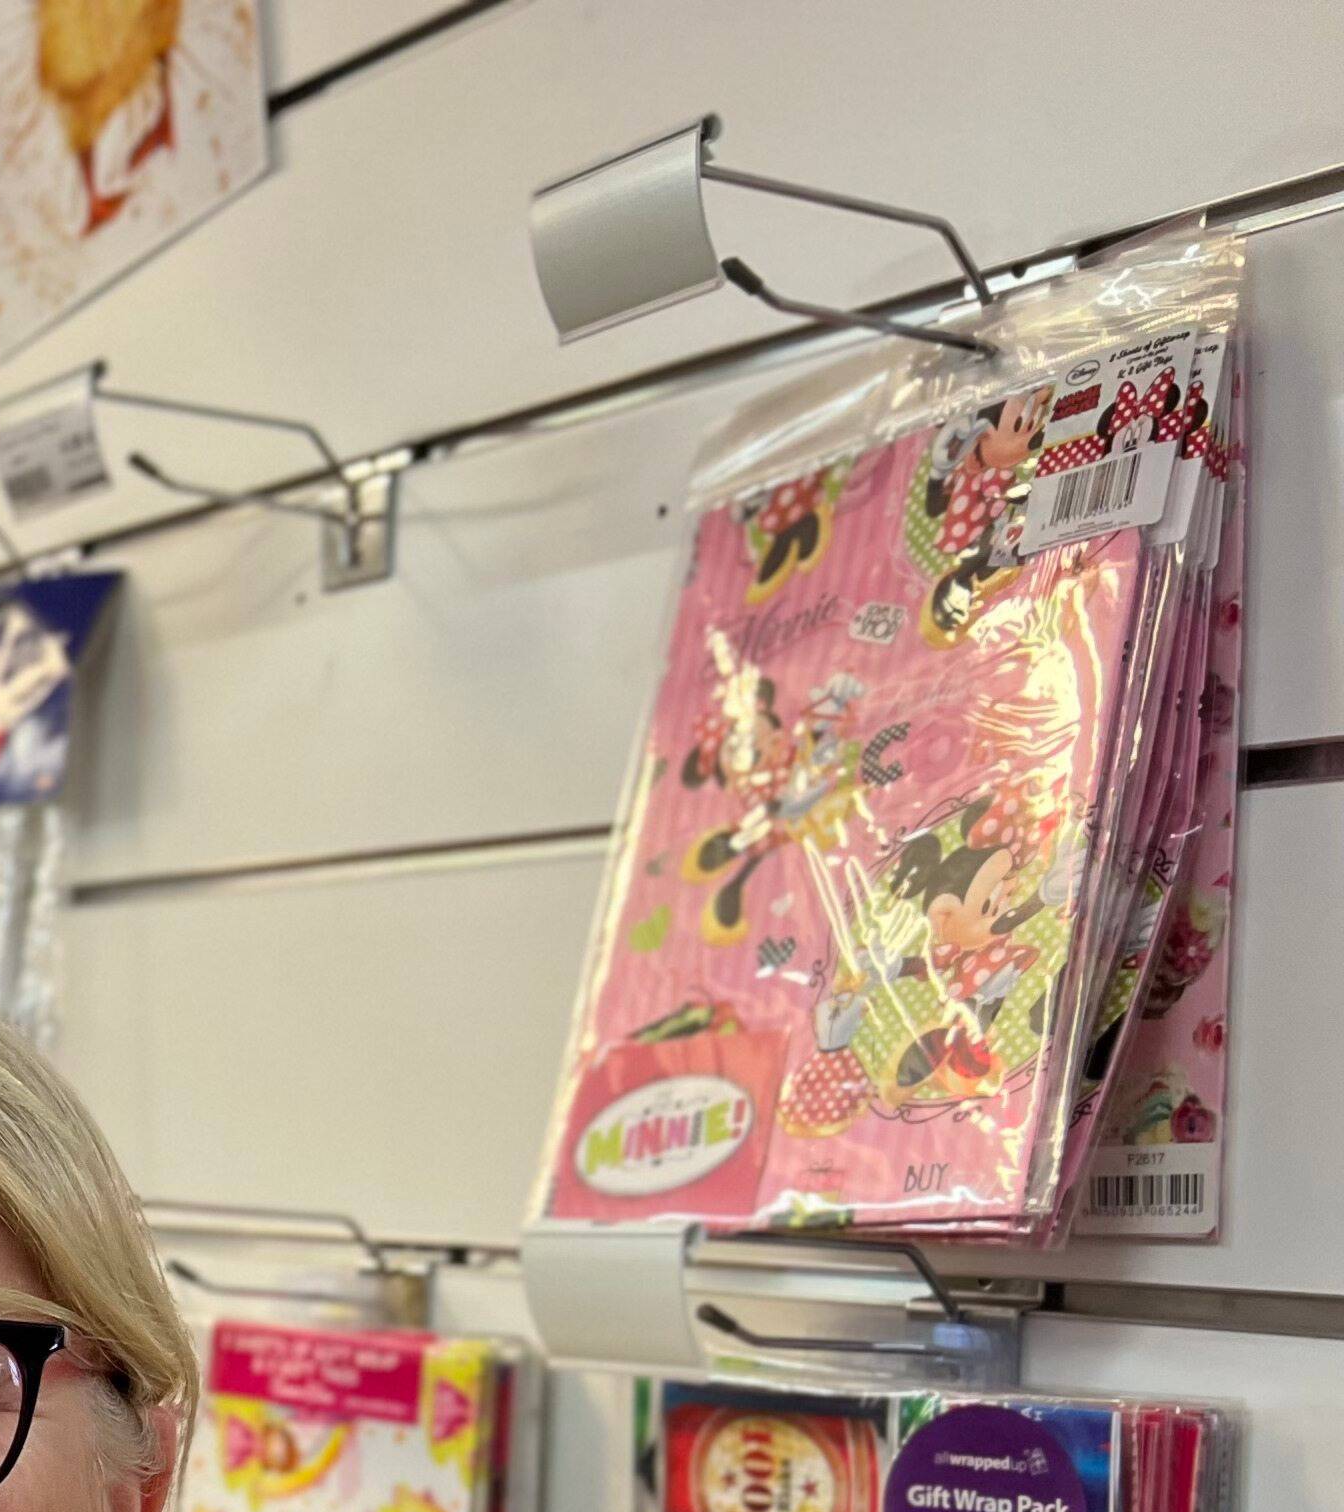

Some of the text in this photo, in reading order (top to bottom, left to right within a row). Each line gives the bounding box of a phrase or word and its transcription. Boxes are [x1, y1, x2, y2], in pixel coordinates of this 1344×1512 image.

[586, 1099, 746, 1174] MINNIE!
[904, 1162, 950, 1191] BUY
[907, 1484, 951, 1509] Gift
